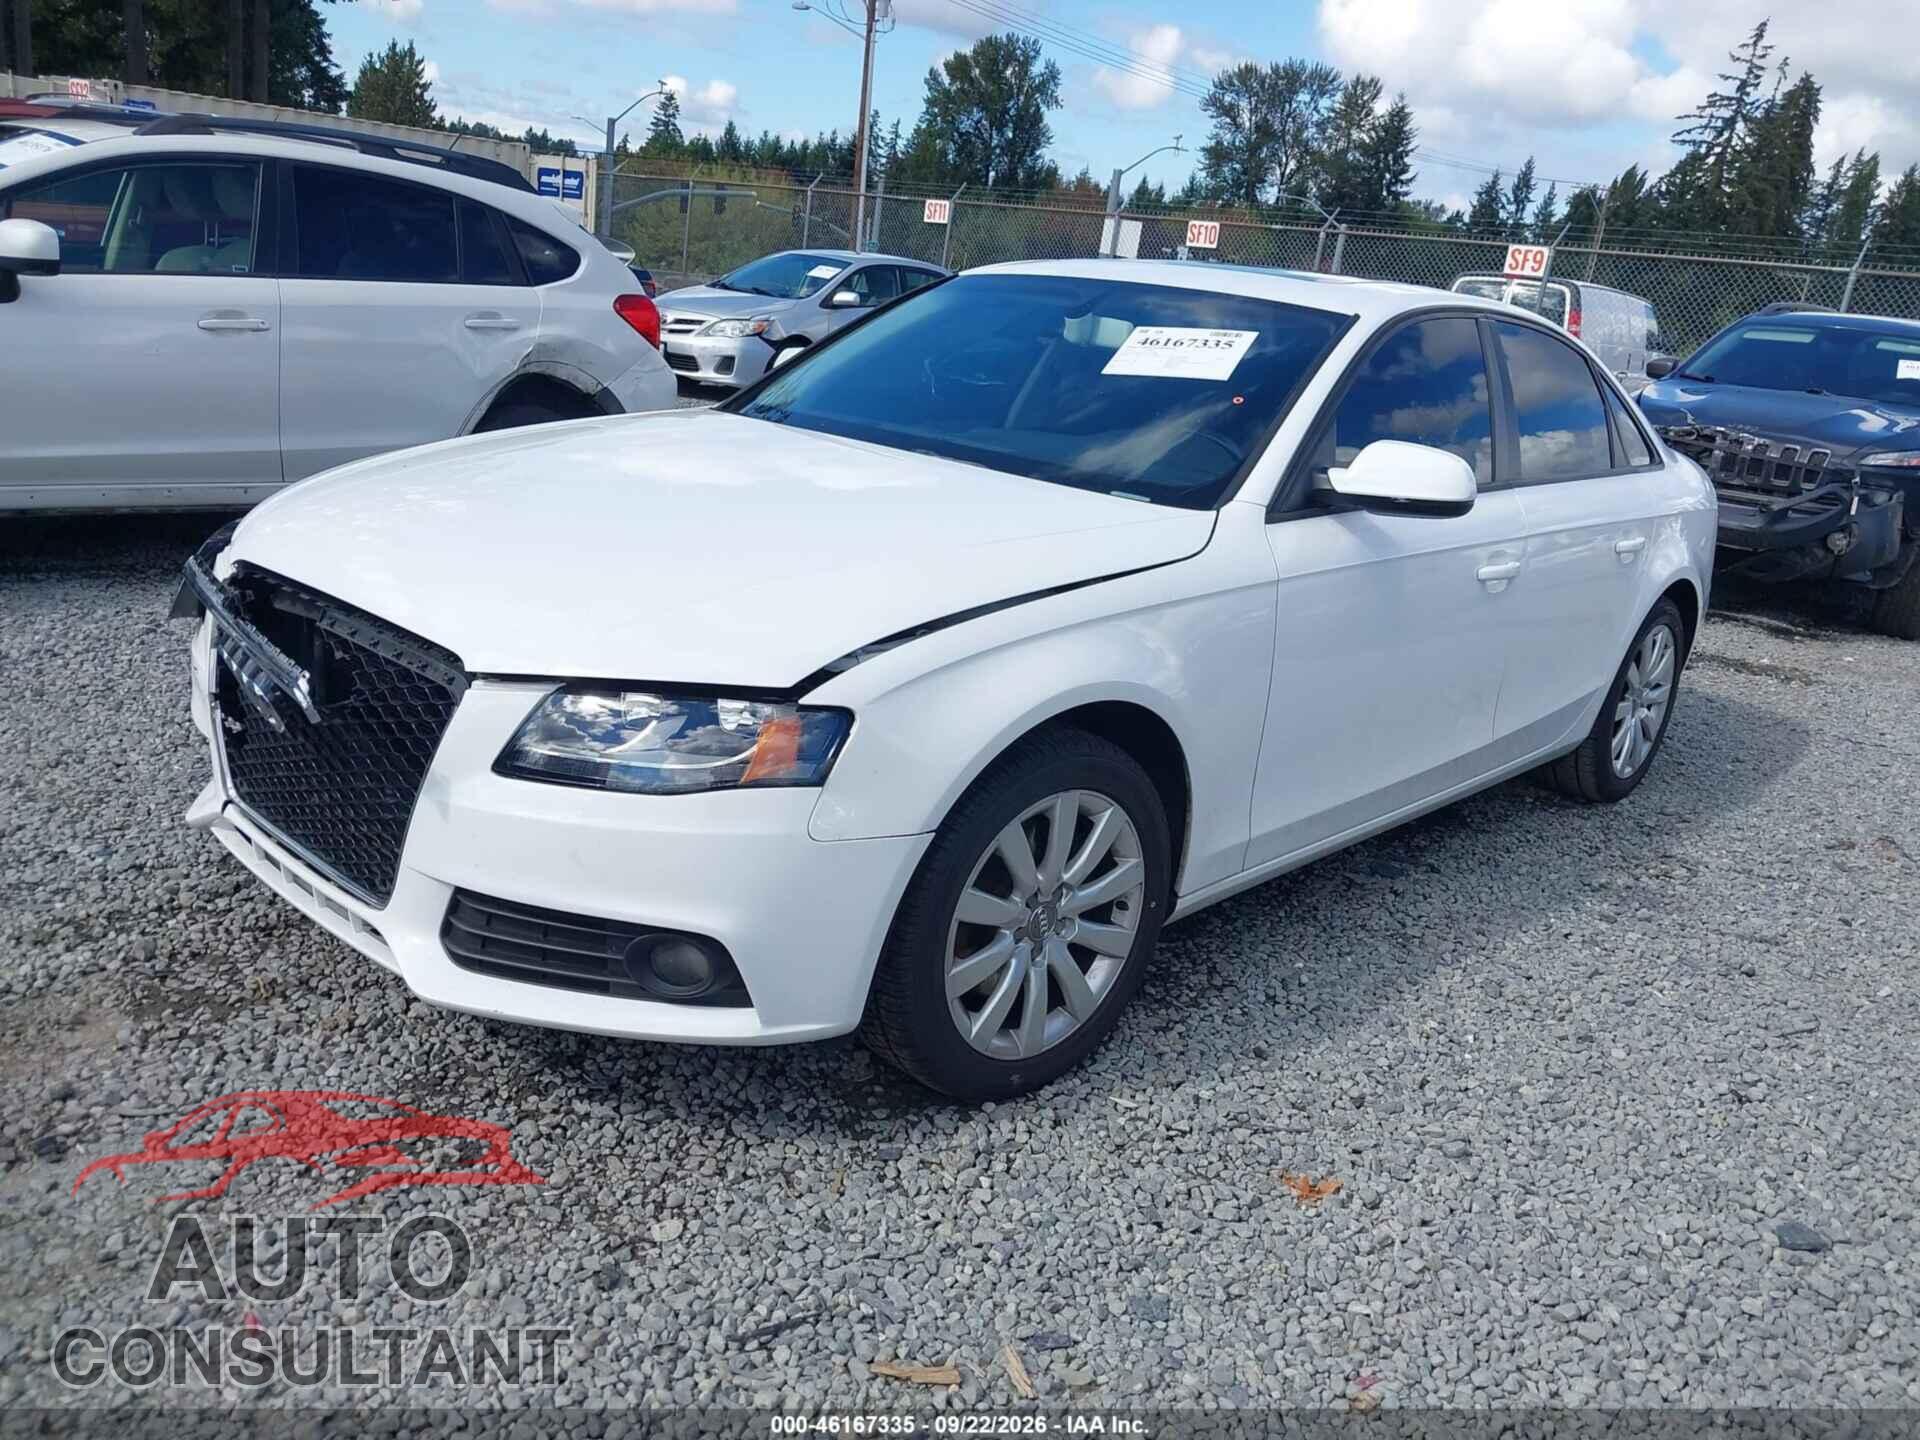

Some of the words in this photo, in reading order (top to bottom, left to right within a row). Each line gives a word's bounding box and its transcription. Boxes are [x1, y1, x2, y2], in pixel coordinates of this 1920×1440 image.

[926, 202, 948, 221] SF11
[1188, 223, 1218, 245] SF10
[1508, 248, 1545, 273] SF9
[1136, 337, 1236, 350] 46167335
